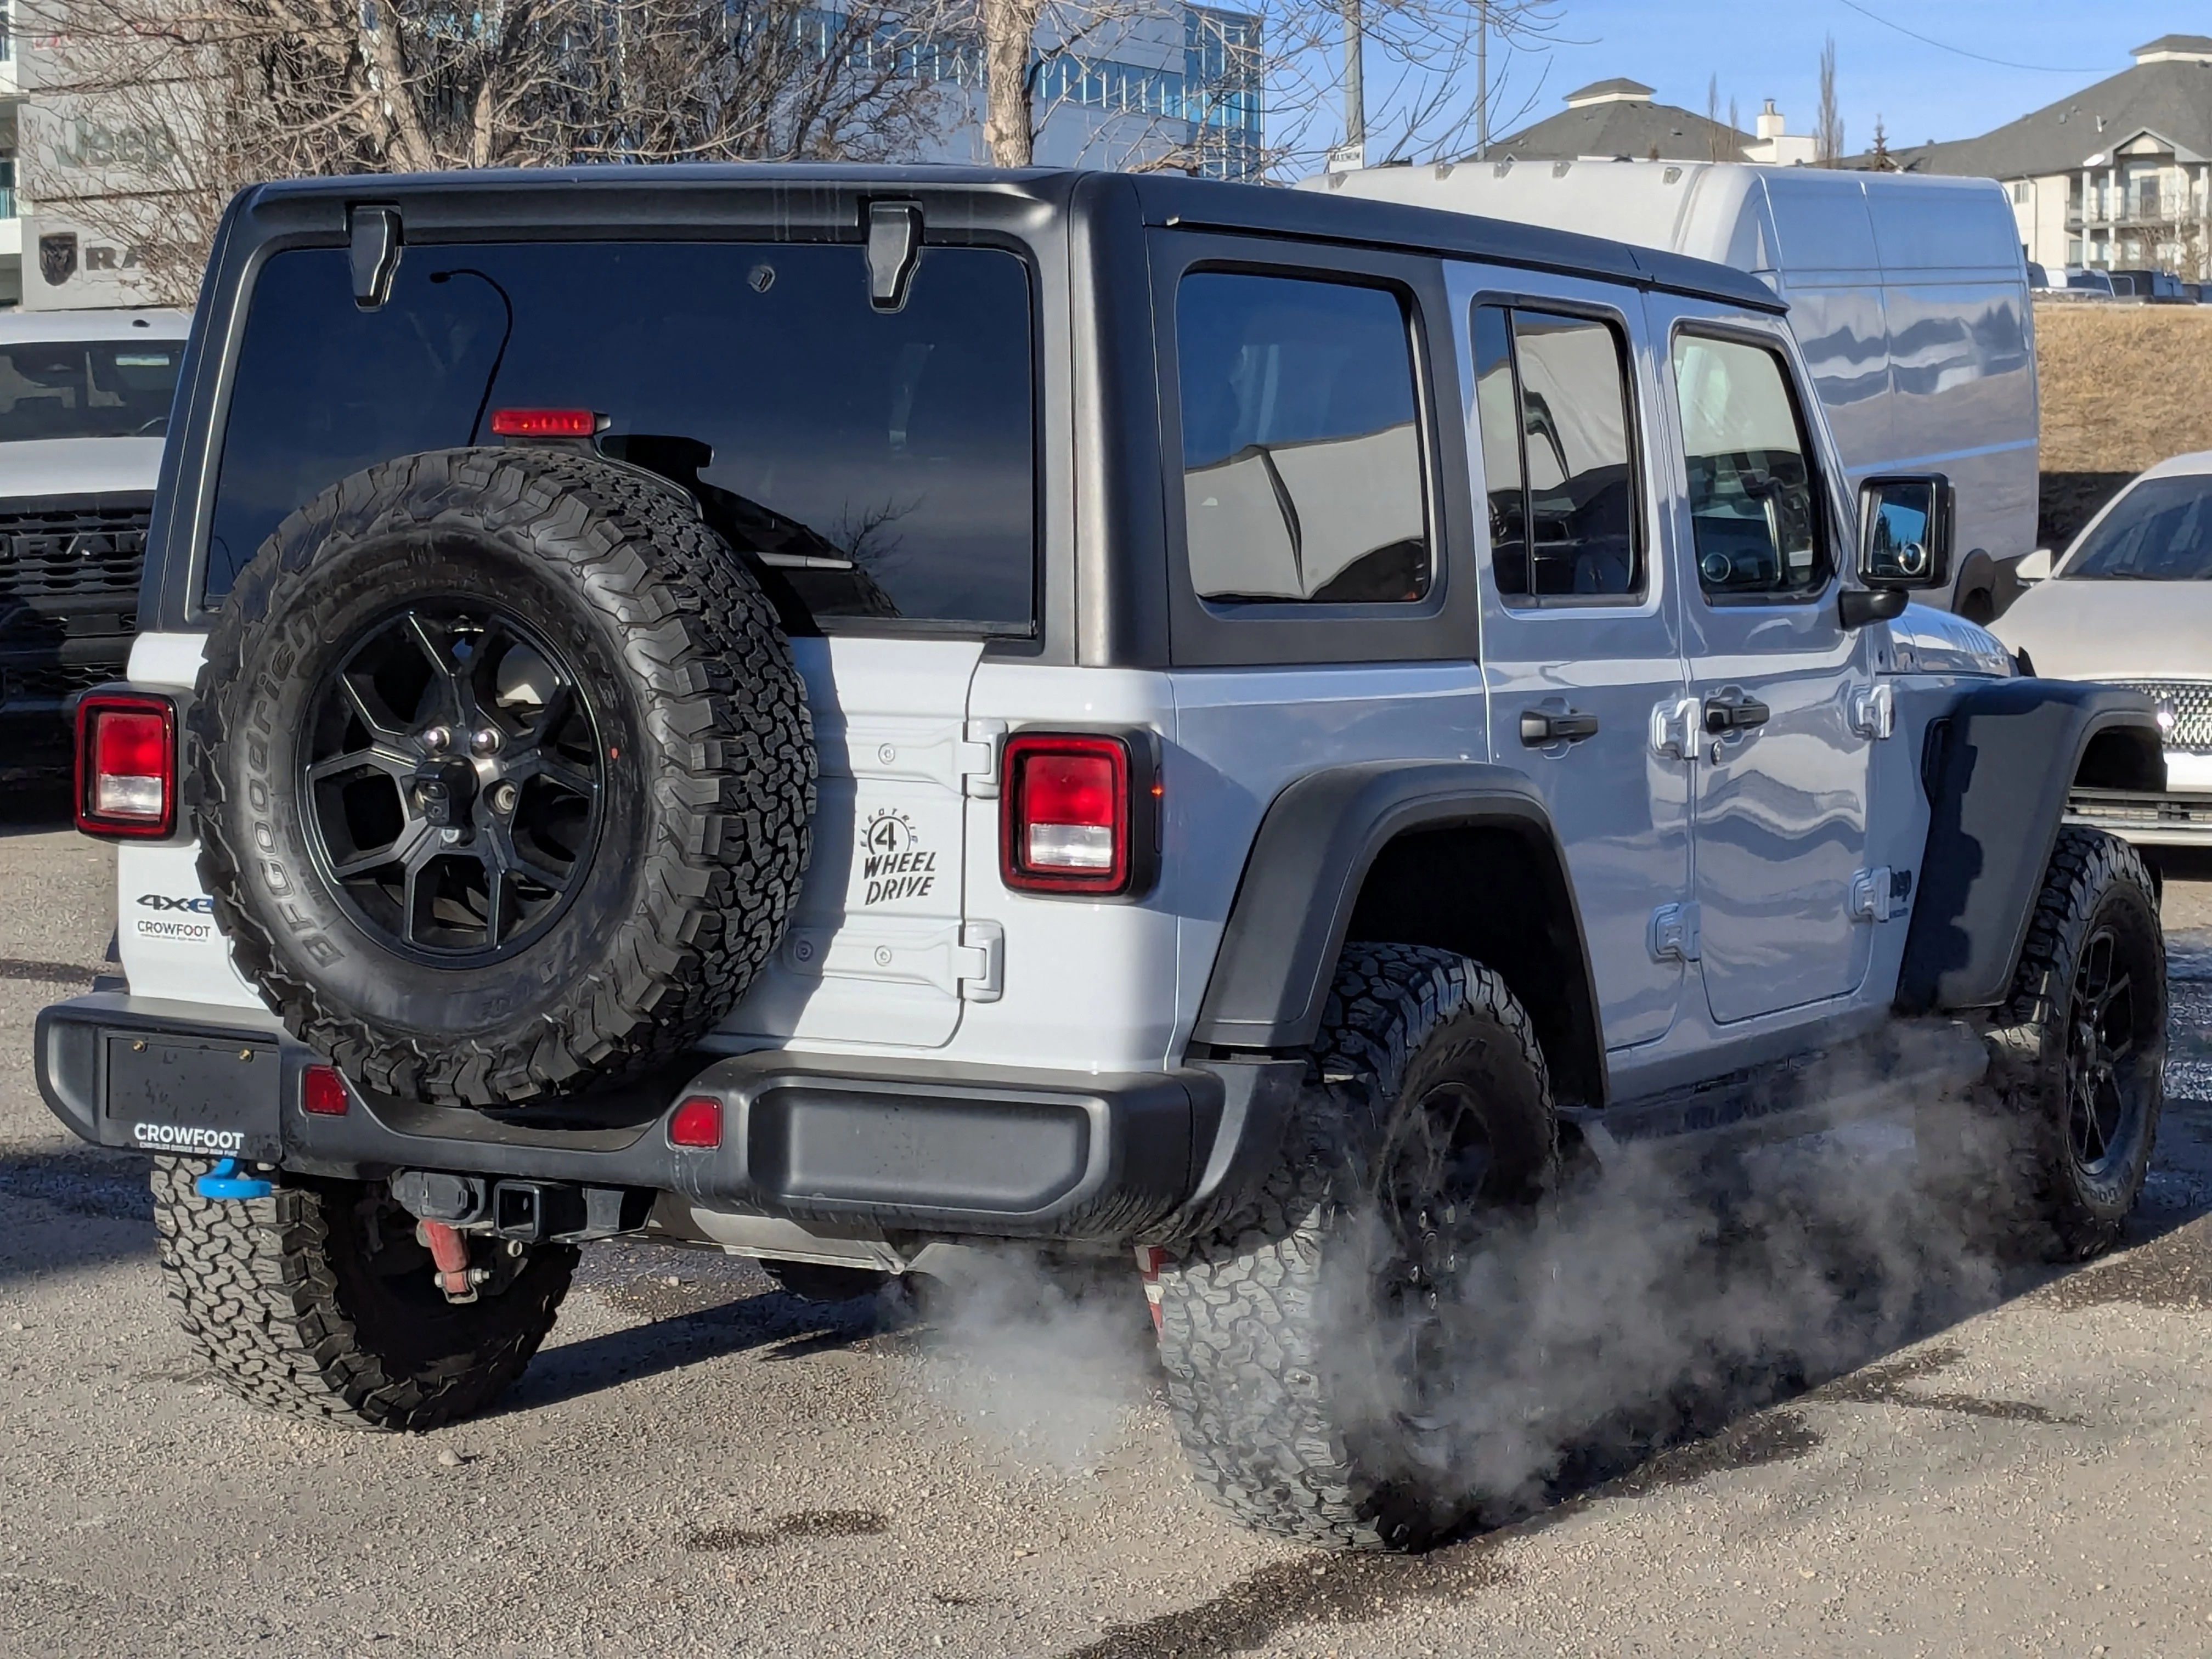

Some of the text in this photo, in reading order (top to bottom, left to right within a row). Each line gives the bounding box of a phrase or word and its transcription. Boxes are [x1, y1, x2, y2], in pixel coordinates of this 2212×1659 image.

[874, 821, 897, 852] 4
[864, 851, 936, 879] WHEEL
[865, 876, 935, 906] DRIVE
[137, 920, 211, 938] CROWFOOT
[134, 1122, 245, 1149] CROWFOOT
